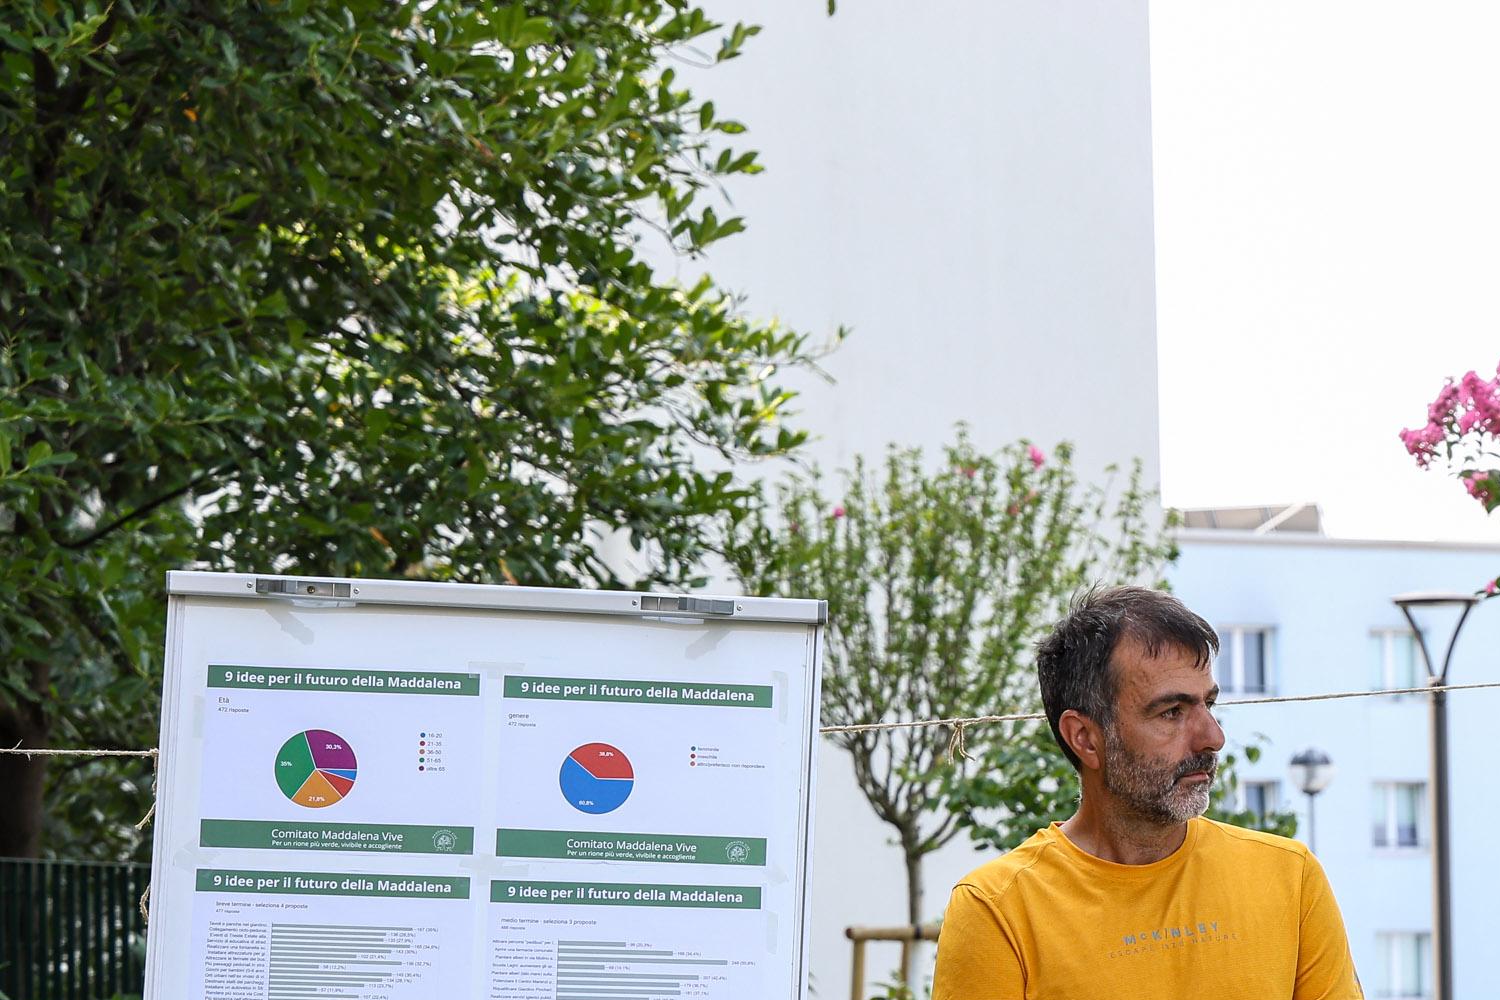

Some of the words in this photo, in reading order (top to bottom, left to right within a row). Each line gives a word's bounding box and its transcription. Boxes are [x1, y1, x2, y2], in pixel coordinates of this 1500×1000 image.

[225, 671, 234, 682] 9
[236, 671, 265, 684] idee
[268, 675, 292, 687] per
[294, 673, 302, 685] il
[305, 673, 349, 686] futuro
[351, 675, 384, 687] della
[388, 677, 462, 690] Maddalena
[521, 682, 530, 693] 9
[532, 682, 561, 694] idee
[564, 686, 587, 698] per
[589, 684, 598, 696] il
[600, 684, 643, 697] futuro
[646, 686, 678, 699] della
[682, 688, 755, 702] Maddalena
[218, 696, 230, 705] Età
[271, 828, 319, 840] Comitato
[321, 830, 380, 841] Maddalena
[381, 832, 404, 842] Vive
[309, 841, 321, 849] più
[368, 843, 403, 851] accogliente
[567, 838, 614, 850] Comitato
[616, 840, 674, 852] Maddalena
[675, 842, 697, 853] Vive
[567, 849, 578, 857] Per
[615, 851, 635, 859] verde,
[662, 854, 696, 862] accogliente
[214, 875, 222, 886] 9
[225, 875, 254, 887] idee
[257, 879, 281, 891] per
[283, 877, 292, 888] il
[294, 877, 338, 890] futuro
[341, 878, 374, 891] della
[377, 880, 452, 893] Maddalena
[508, 886, 516, 897] 9
[519, 886, 548, 898] idee
[551, 889, 574, 901] per
[576, 887, 585, 899] il
[588, 887, 631, 900] futuro
[634, 889, 666, 901] della
[670, 890, 743, 903] Maddalena
